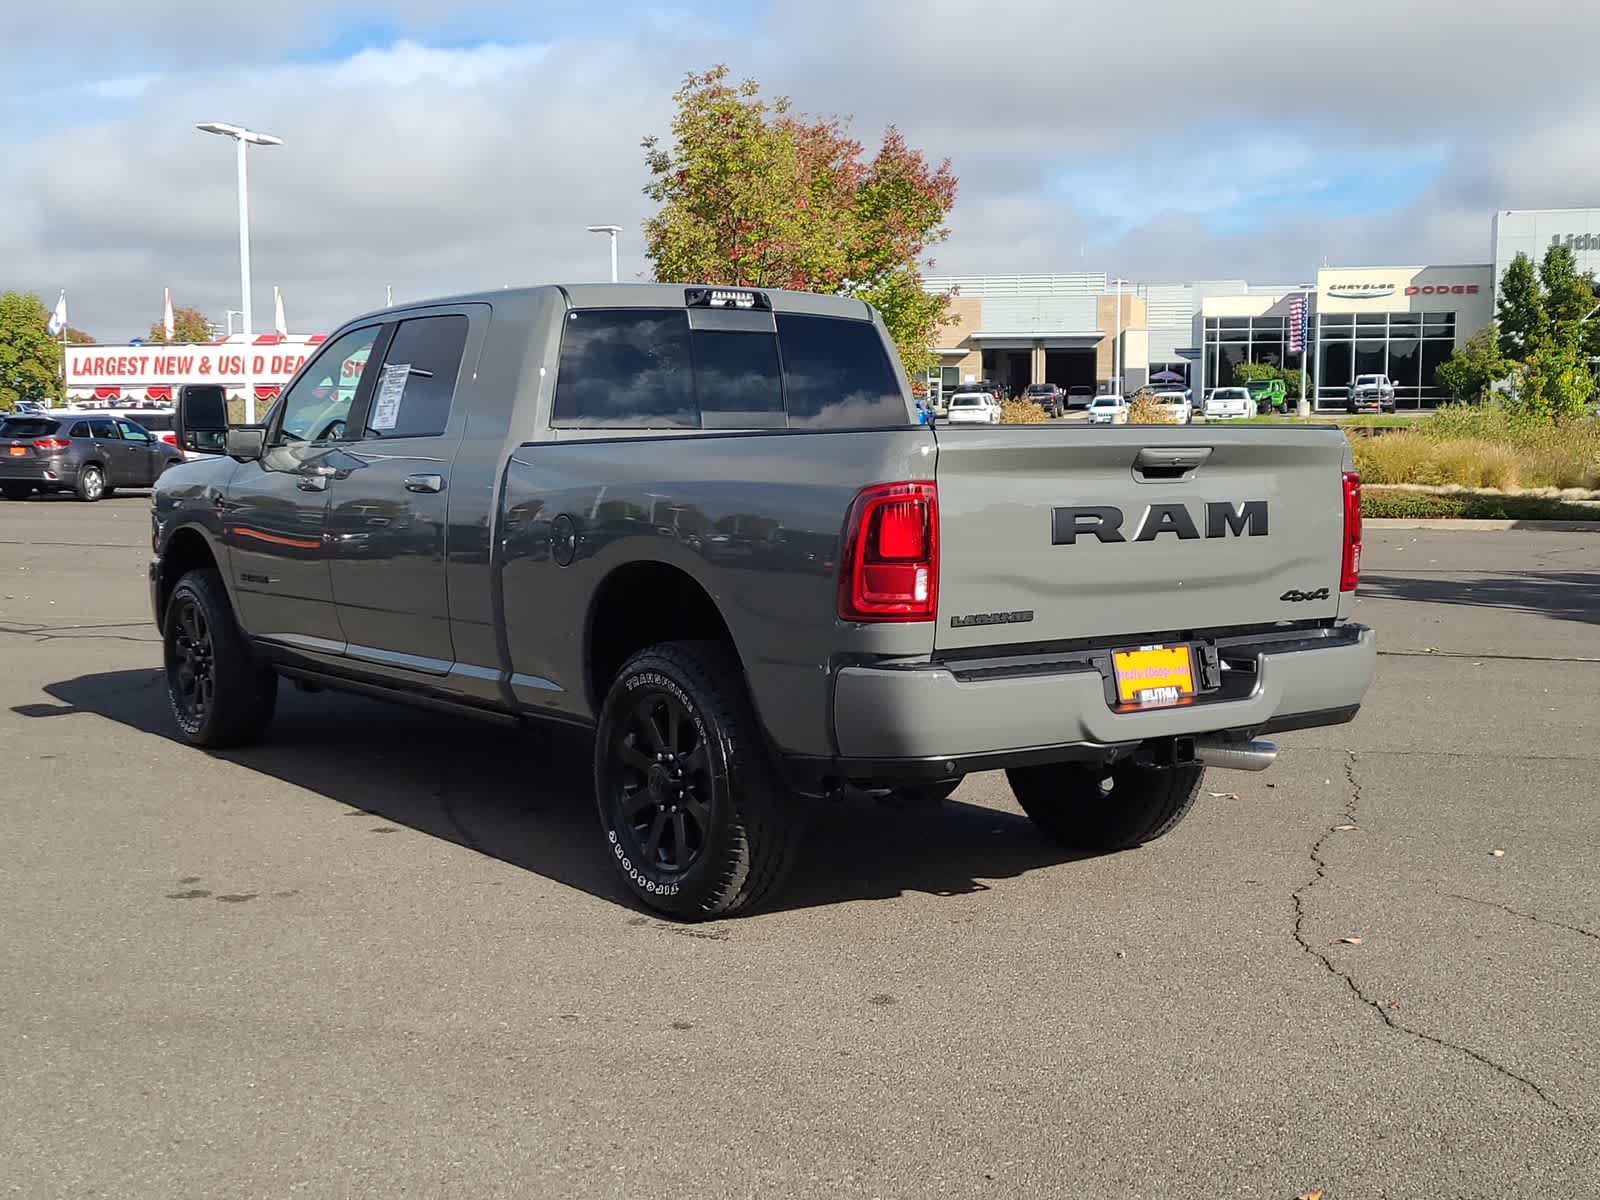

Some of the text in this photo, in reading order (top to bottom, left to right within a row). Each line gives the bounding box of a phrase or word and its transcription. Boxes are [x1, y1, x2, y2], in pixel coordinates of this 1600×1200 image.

[1405, 285, 1479, 296] DODGE
[72, 356, 149, 376] LARGEST
[153, 355, 193, 375] NEW
[198, 355, 212, 374] &
[1051, 501, 1269, 545] RAM
